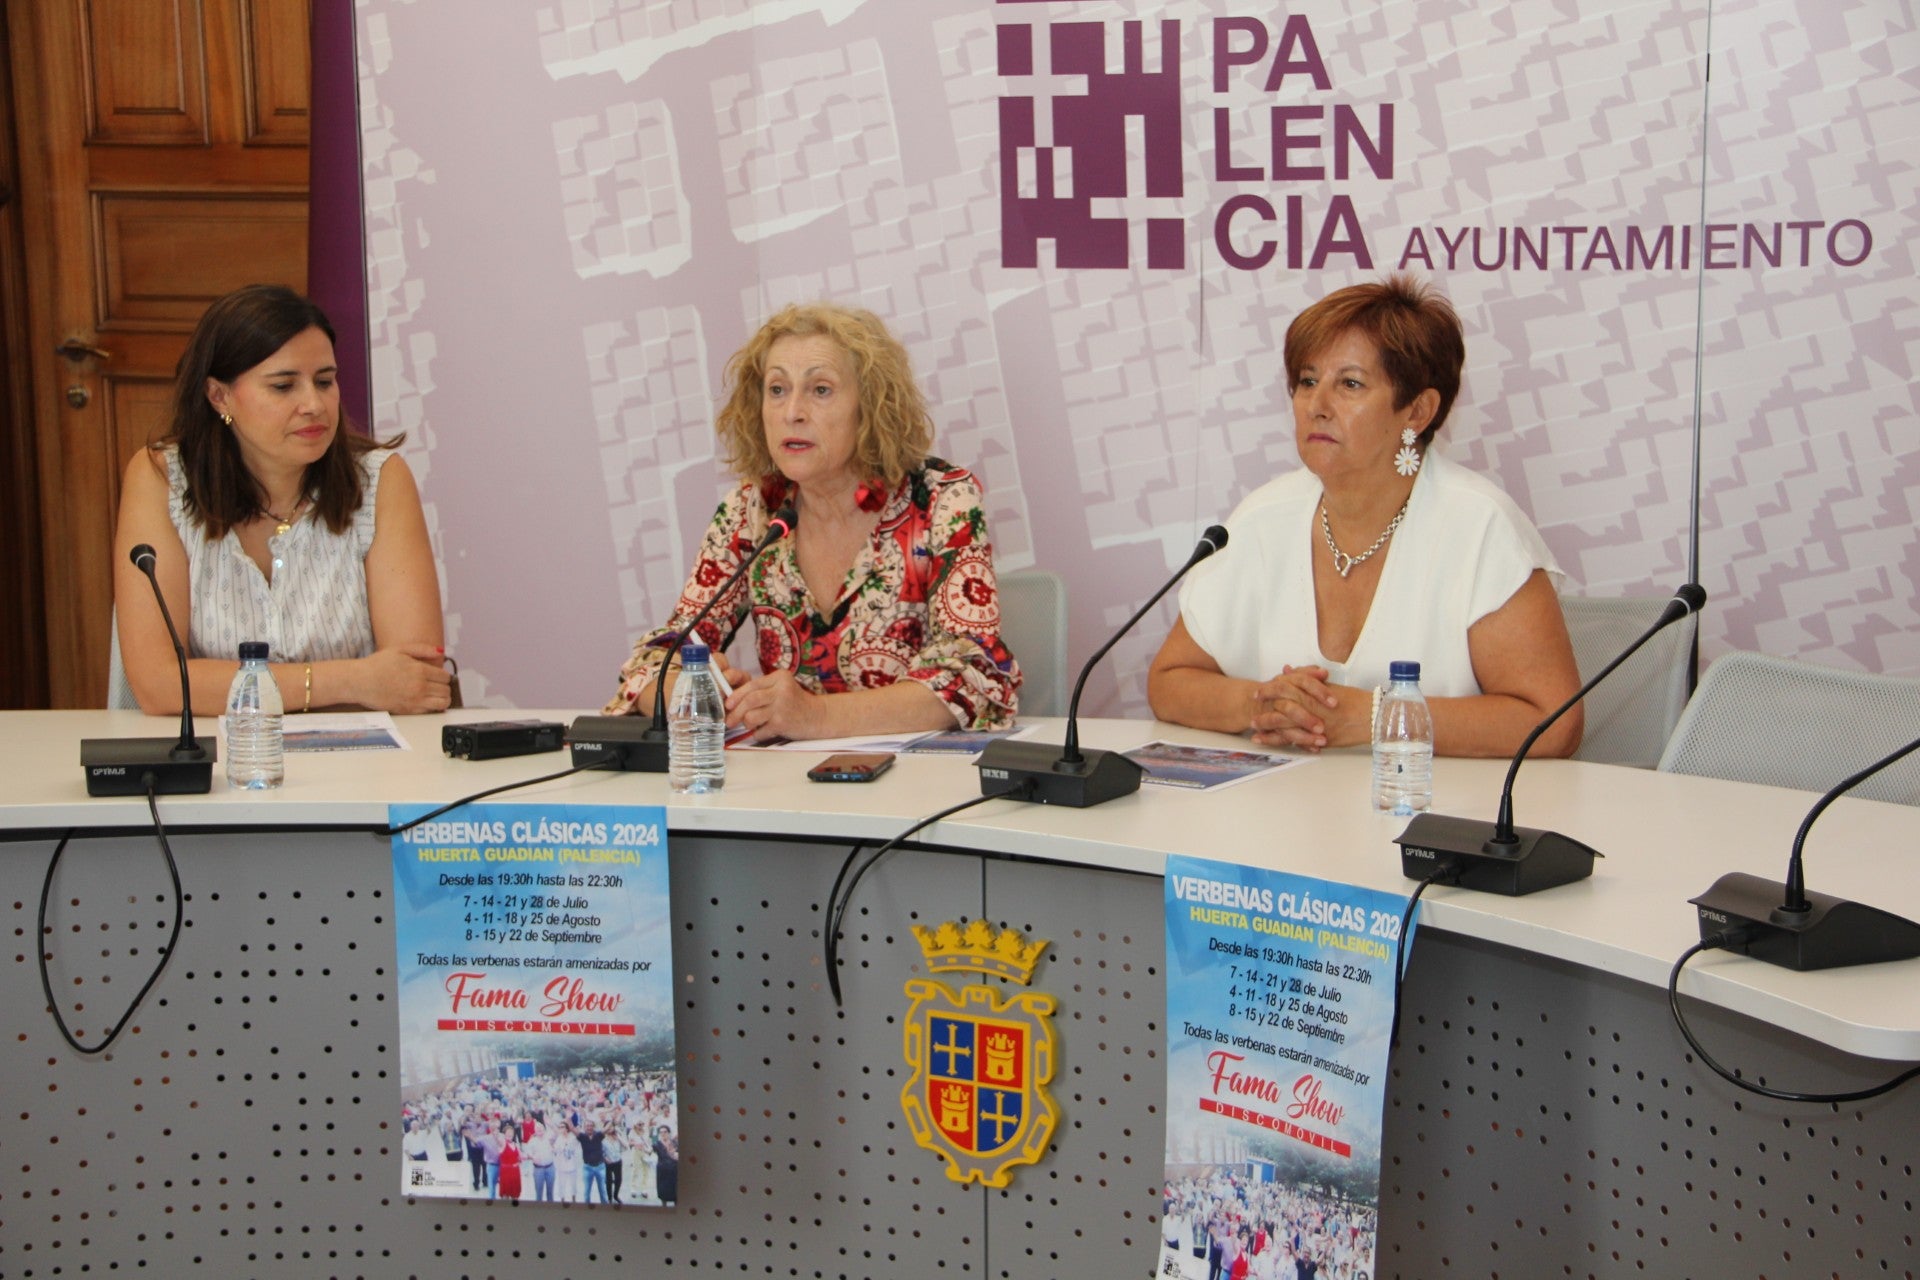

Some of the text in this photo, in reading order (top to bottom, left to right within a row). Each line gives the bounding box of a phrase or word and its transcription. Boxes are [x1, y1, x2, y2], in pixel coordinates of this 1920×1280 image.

[1214, 14, 1332, 93] PA
[1214, 103, 1394, 181] LEN
[1214, 194, 1374, 270] CIA
[1397, 218, 1873, 271] AYUNTAMIENTO
[398, 817, 659, 846] VERBENAS CLÁSICAS 2024
[418, 848, 641, 866] HUERTA GUADIAN (PALENCIA)
[439, 874, 623, 888] Desde las 19:30h hasta las 22:30h
[464, 896, 471, 907] 7
[481, 896, 494, 907] 14
[505, 896, 517, 908] 21
[521, 898, 527, 910] y
[530, 896, 543, 908] 28
[546, 896, 559, 909] de
[562, 896, 588, 909] Julio
[464, 913, 471, 924] 4
[482, 913, 494, 924] 11
[505, 913, 518, 925] 18
[521, 915, 527, 927] y
[531, 913, 543, 925] 25
[546, 913, 560, 926] de
[562, 914, 600, 928] Agosto
[1172, 875, 1402, 941] VERBENAS CLÁSICAS 202
[466, 930, 472, 941] 8
[483, 930, 495, 941] 15
[499, 932, 506, 944] y
[509, 930, 522, 941] 22
[525, 930, 538, 942] de
[541, 930, 602, 946] Septiembre
[1190, 906, 1390, 964] HUERTA GUADIAN (PALENCIA)
[417, 953, 651, 973] Todas las verbenas estarán amenizadas por
[1209, 937, 1372, 985] Desde las 19:30h hasta las 22:30h
[445, 972, 623, 1017] Fama Show
[1229, 985, 1236, 998] 4
[1246, 988, 1255, 1002] 11
[1265, 992, 1276, 1006] 18
[1279, 997, 1285, 1011] y
[1288, 997, 1300, 1012] 25
[1302, 1001, 1314, 1015] de
[1316, 1003, 1348, 1025] Agosto
[1230, 966, 1236, 979] 7
[1246, 969, 1257, 983] 14
[1266, 973, 1277, 987] 21
[1280, 979, 1287, 992] y
[1289, 979, 1301, 993] 28
[1303, 982, 1316, 997] de
[1318, 985, 1341, 1002] Julio
[456, 1021, 616, 1034] DISCOMOVIL
[1229, 1004, 1235, 1016] 8
[1245, 1007, 1255, 1021] 15
[1259, 1012, 1265, 1025] y
[1268, 1012, 1279, 1027] 22
[1281, 1015, 1294, 1030] de
[1296, 1018, 1345, 1045] Septiembre
[1183, 1022, 1370, 1086] Todas las verbenas estarán amenizadas por
[1207, 1050, 1345, 1126] Fama Show
[1216, 1102, 1337, 1152] DISCOMOVIL
